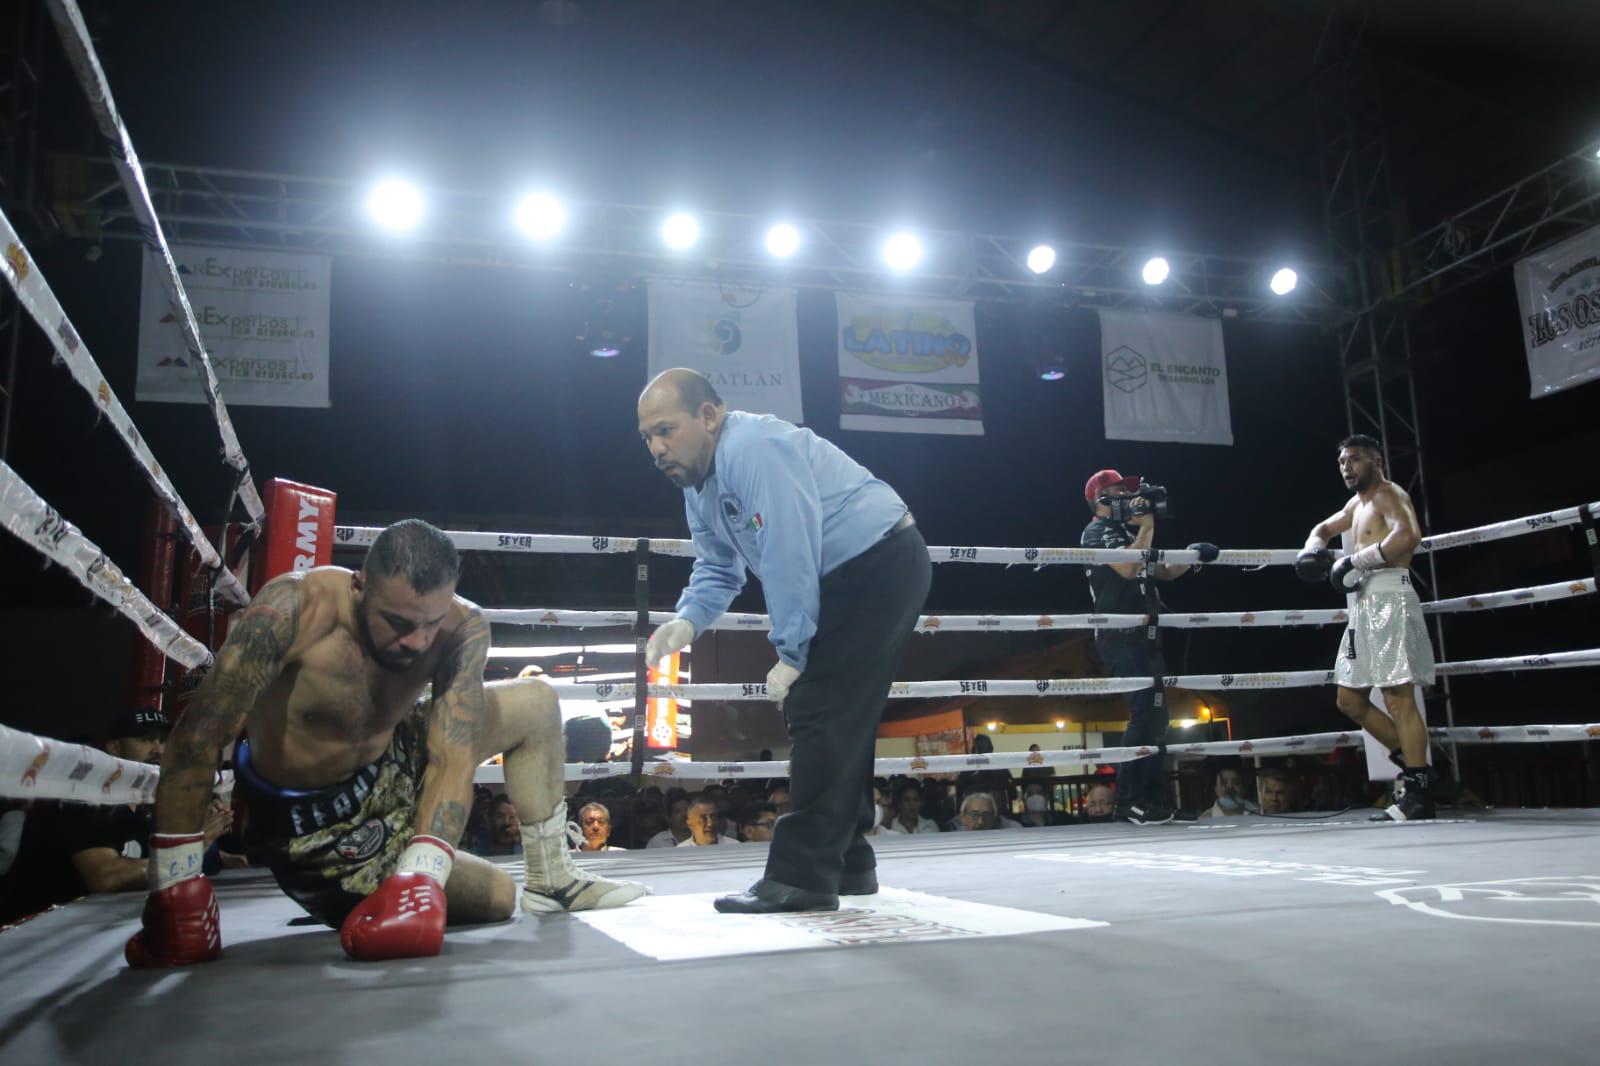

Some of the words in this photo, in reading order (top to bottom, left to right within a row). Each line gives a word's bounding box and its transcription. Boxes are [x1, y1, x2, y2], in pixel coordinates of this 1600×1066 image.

[842, 327, 971, 358] LATINO
[1151, 363, 1163, 373] EL
[1168, 365, 1220, 377] ENCANTO
[868, 391, 956, 408] MEXICANO
[497, 535, 532, 549] SEYER
[950, 548, 977, 560] SEYER
[960, 681, 987, 693] SEYER
